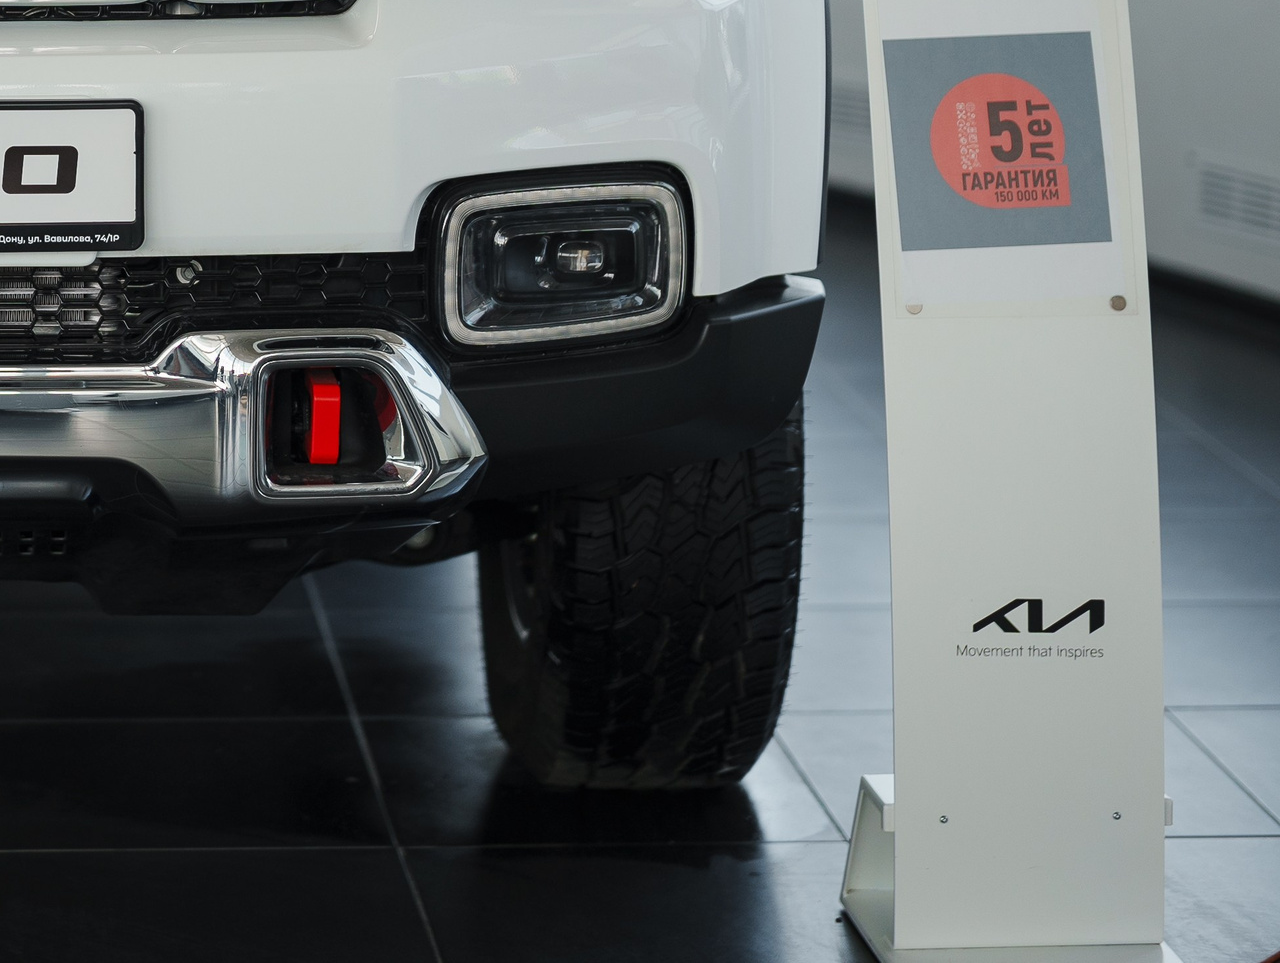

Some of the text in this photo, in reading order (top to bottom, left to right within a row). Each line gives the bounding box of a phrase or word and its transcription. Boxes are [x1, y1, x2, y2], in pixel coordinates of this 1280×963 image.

[987, 100, 1023, 163] 5
[1026, 100, 1055, 161] лет
[962, 169, 1059, 191] ГАРАНТИЯ
[995, 189, 1059, 202] 150 000 КМ
[27, 235, 42, 245] ул.
[44, 234, 93, 244] Вавилова,
[972, 598, 1105, 634] KIA
[956, 644, 1104, 660] Movement that inspires
